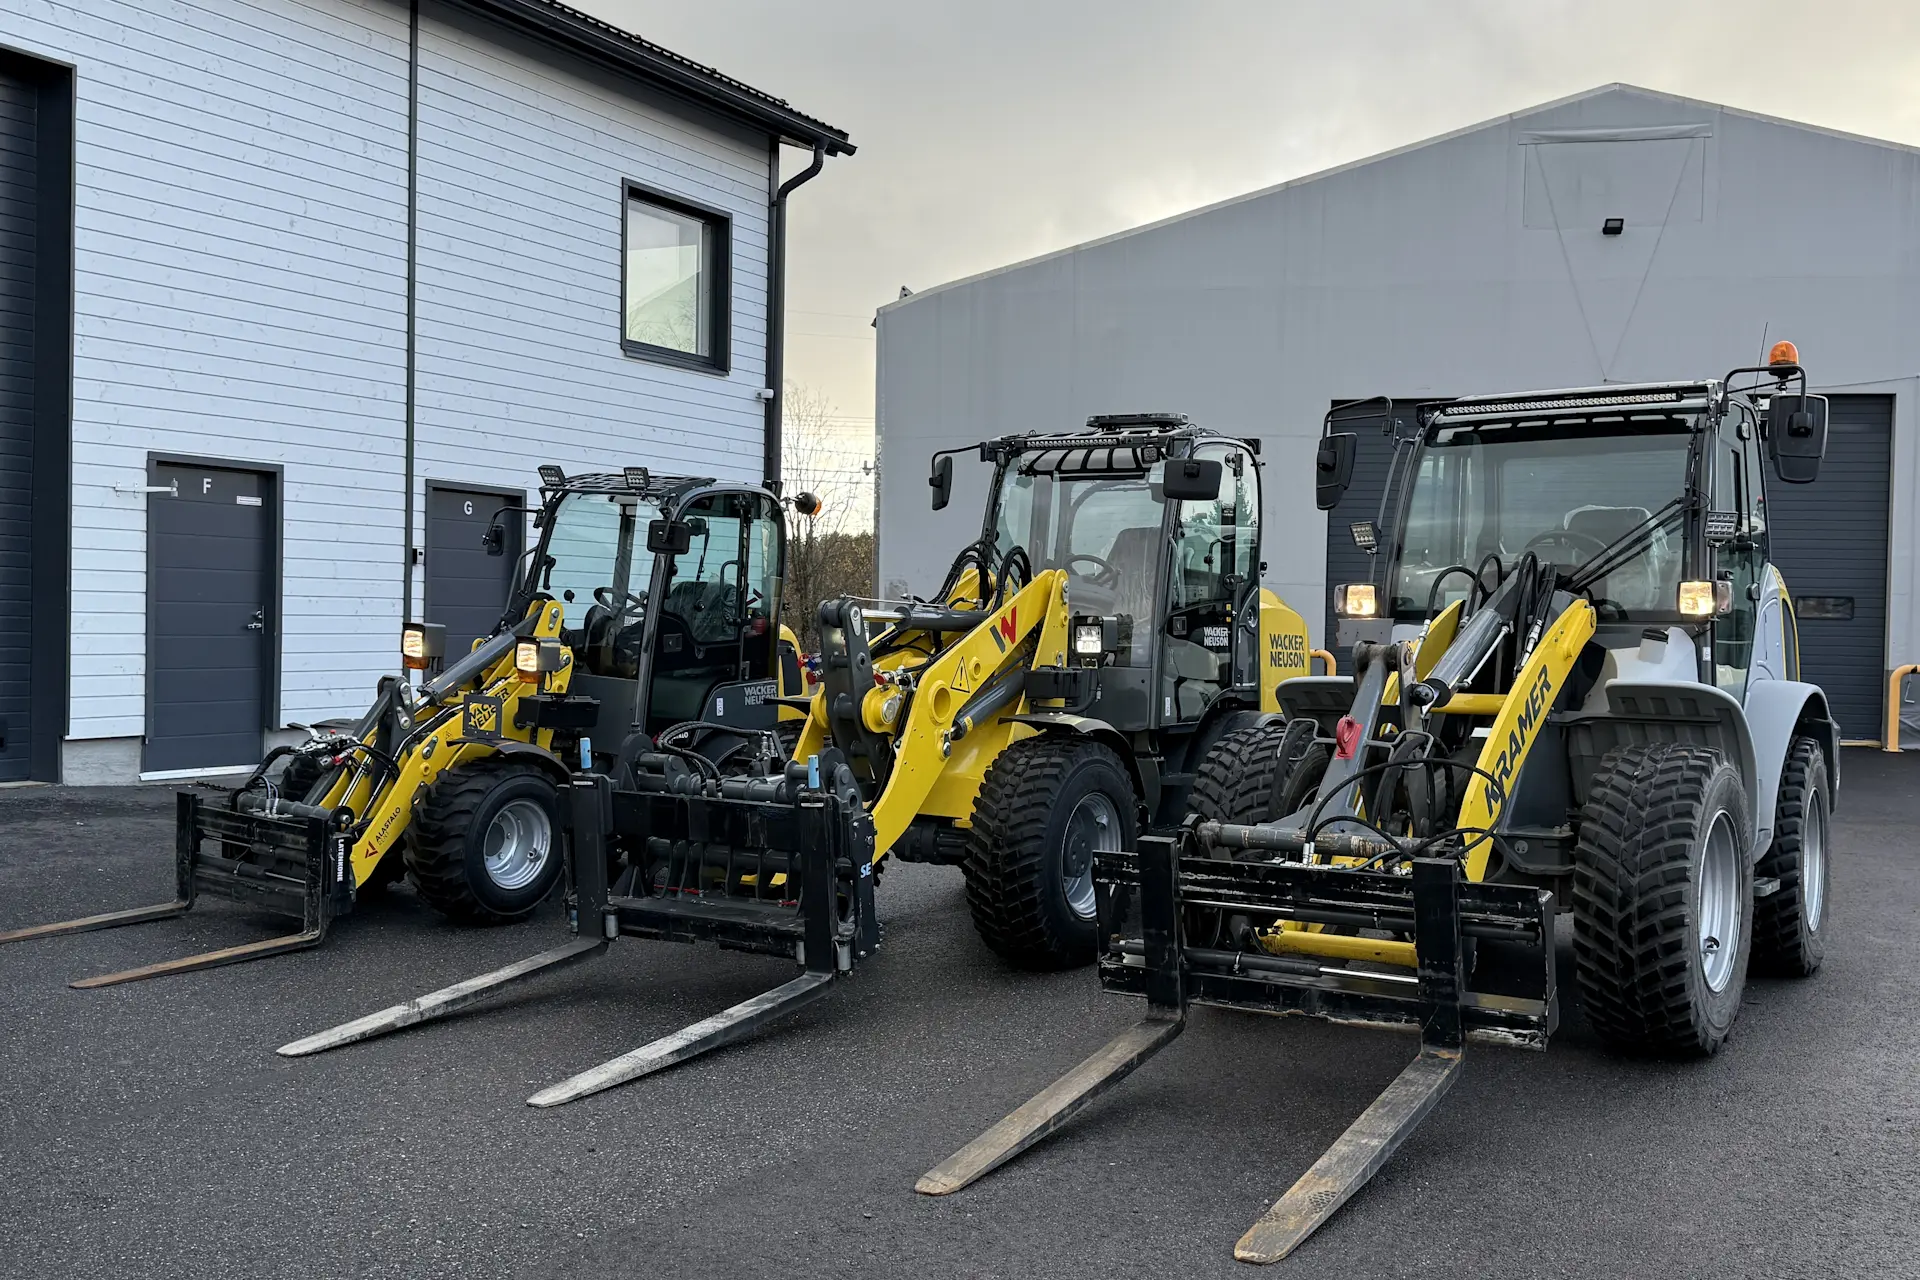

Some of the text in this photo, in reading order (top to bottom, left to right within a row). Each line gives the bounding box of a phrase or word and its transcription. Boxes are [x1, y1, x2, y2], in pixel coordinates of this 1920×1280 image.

[203, 478, 211, 494] F
[464, 501, 473, 516] G
[1204, 627, 1229, 637] WACKER
[1204, 637, 1229, 647] NEUSON
[1269, 633, 1304, 651] WACKER
[1270, 651, 1305, 668] NEUSON
[744, 685, 777, 696] WACKER
[1485, 664, 1551, 818] KRAMER
[375, 807, 401, 842] ALASTALO
